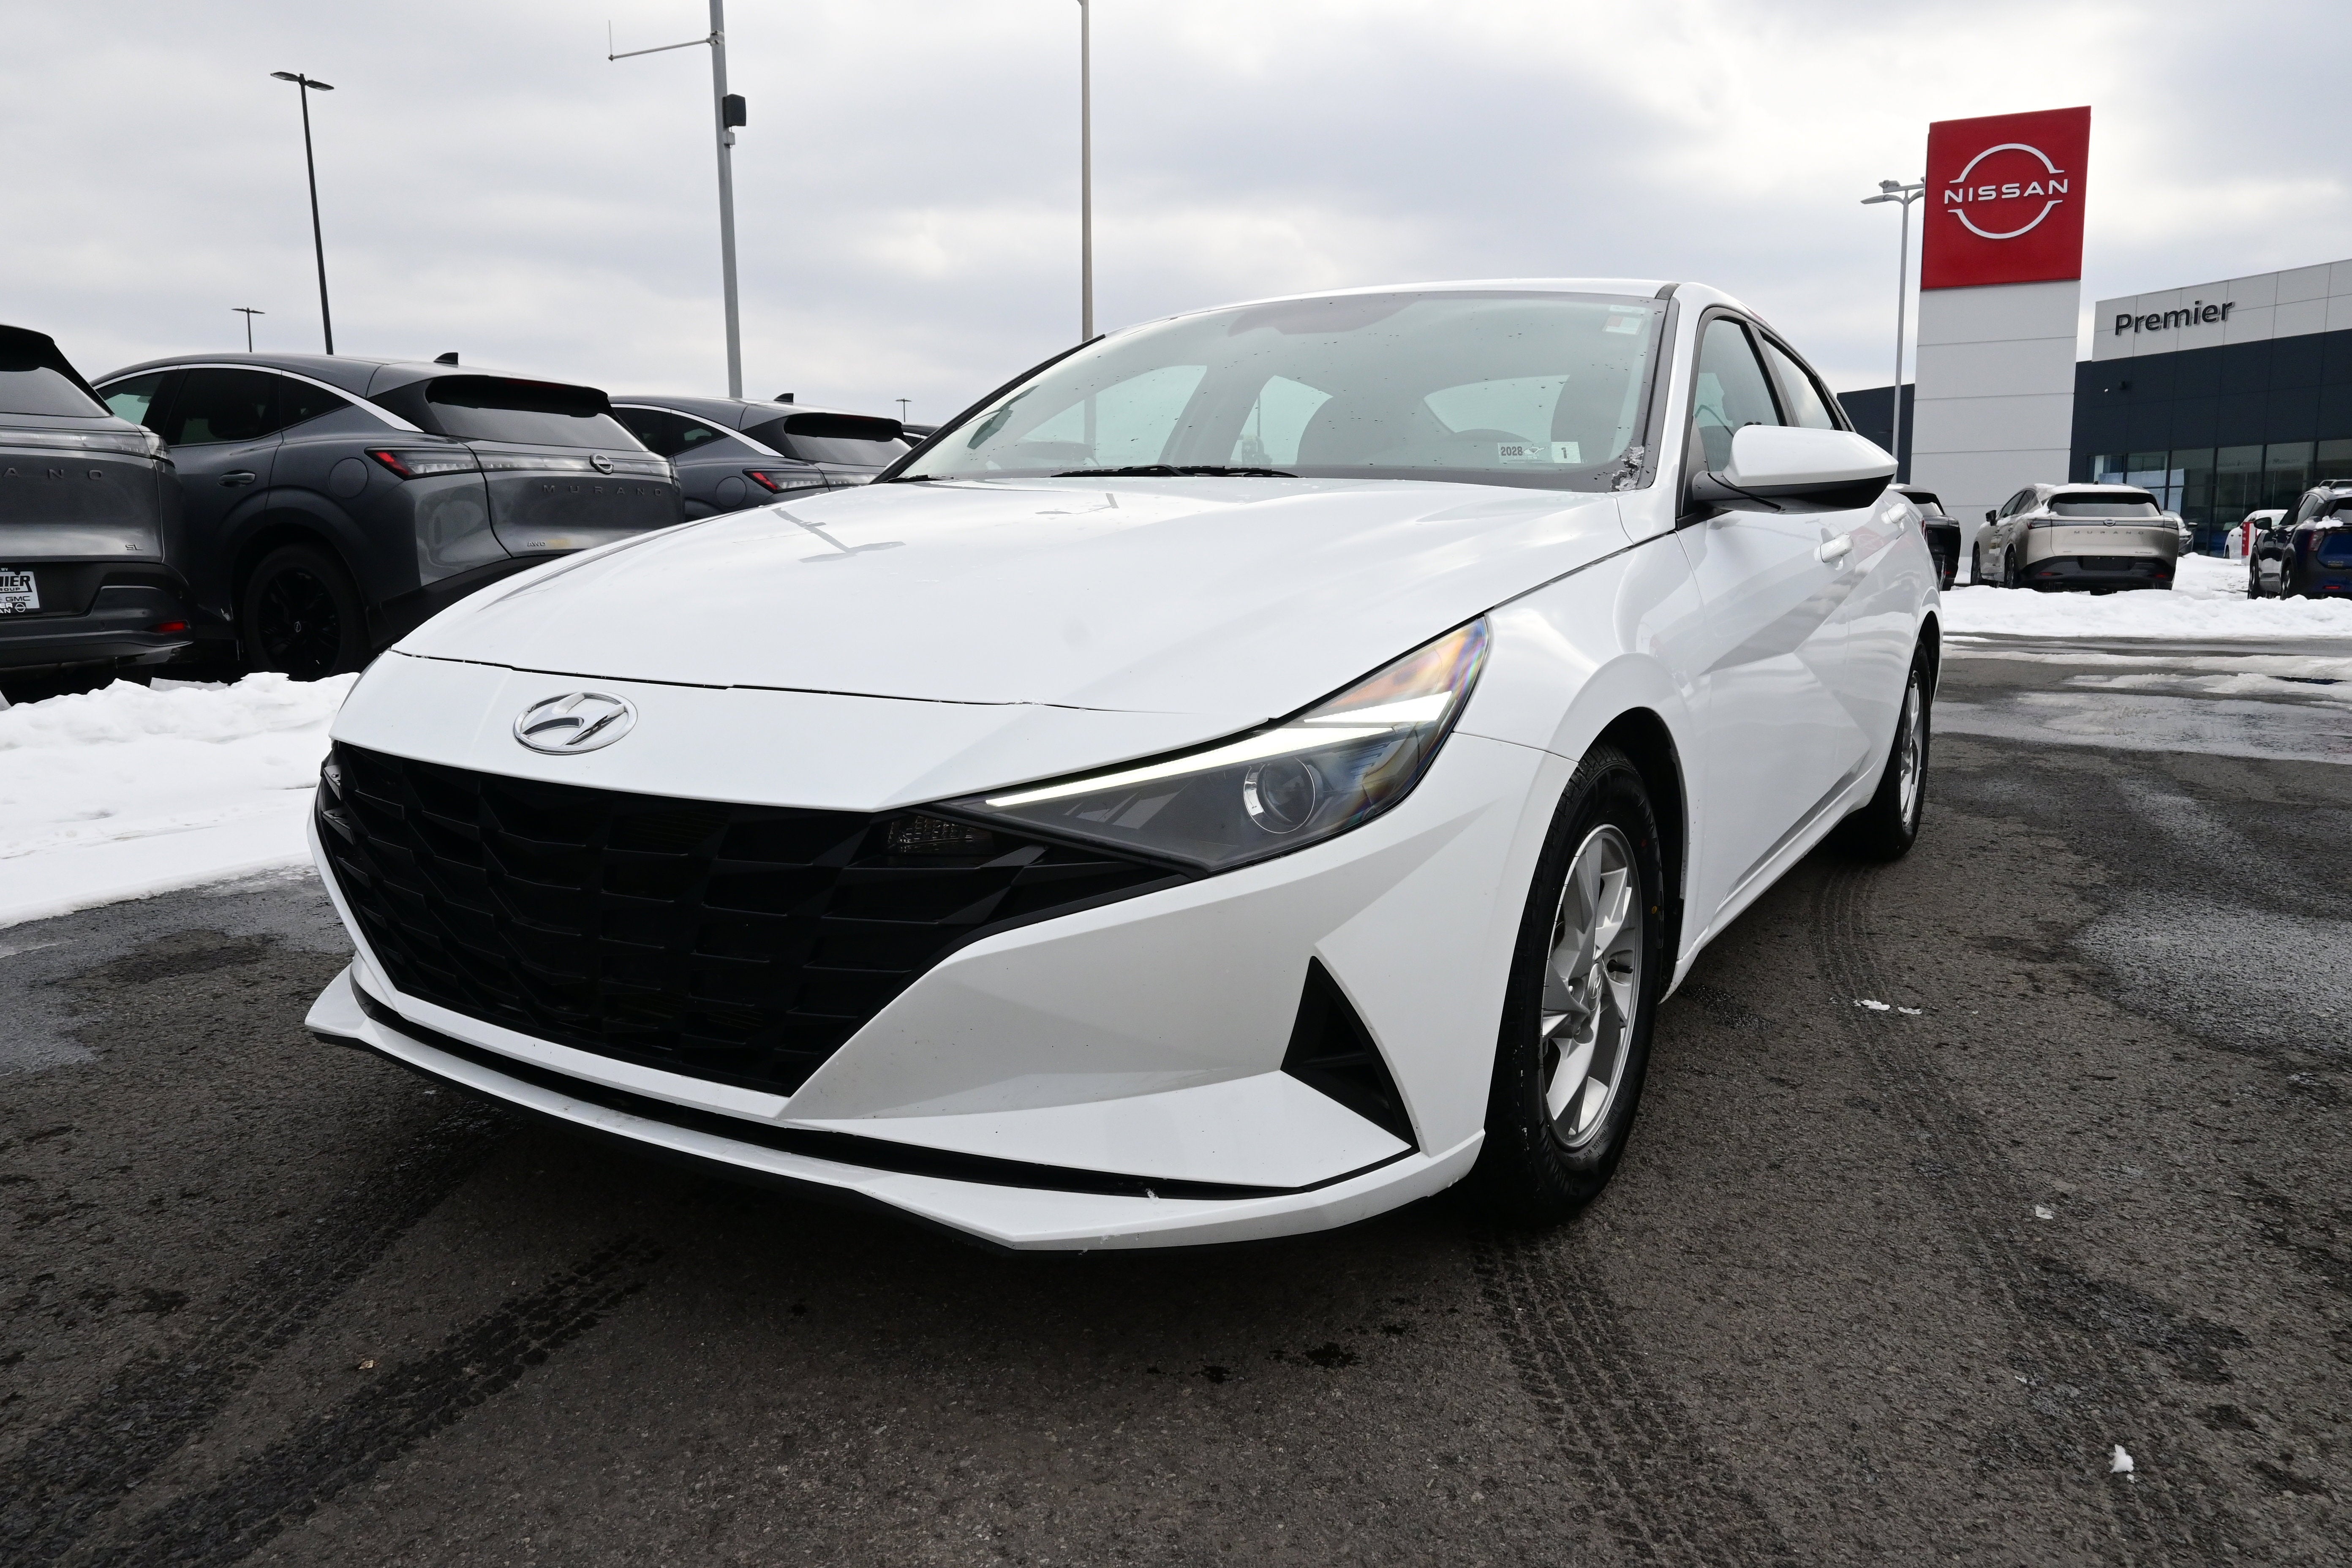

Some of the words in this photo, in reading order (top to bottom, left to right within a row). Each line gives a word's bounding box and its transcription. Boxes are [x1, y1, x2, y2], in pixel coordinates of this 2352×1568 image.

[1944, 178, 2068, 204] NISSAN
[2114, 300, 2235, 336] Premier
[1501, 446, 1523, 456] 2028
[1561, 447, 1567, 459] 1
[543, 485, 662, 495] MURANO
[1591, 1129, 1607, 1150] TUBELESS
